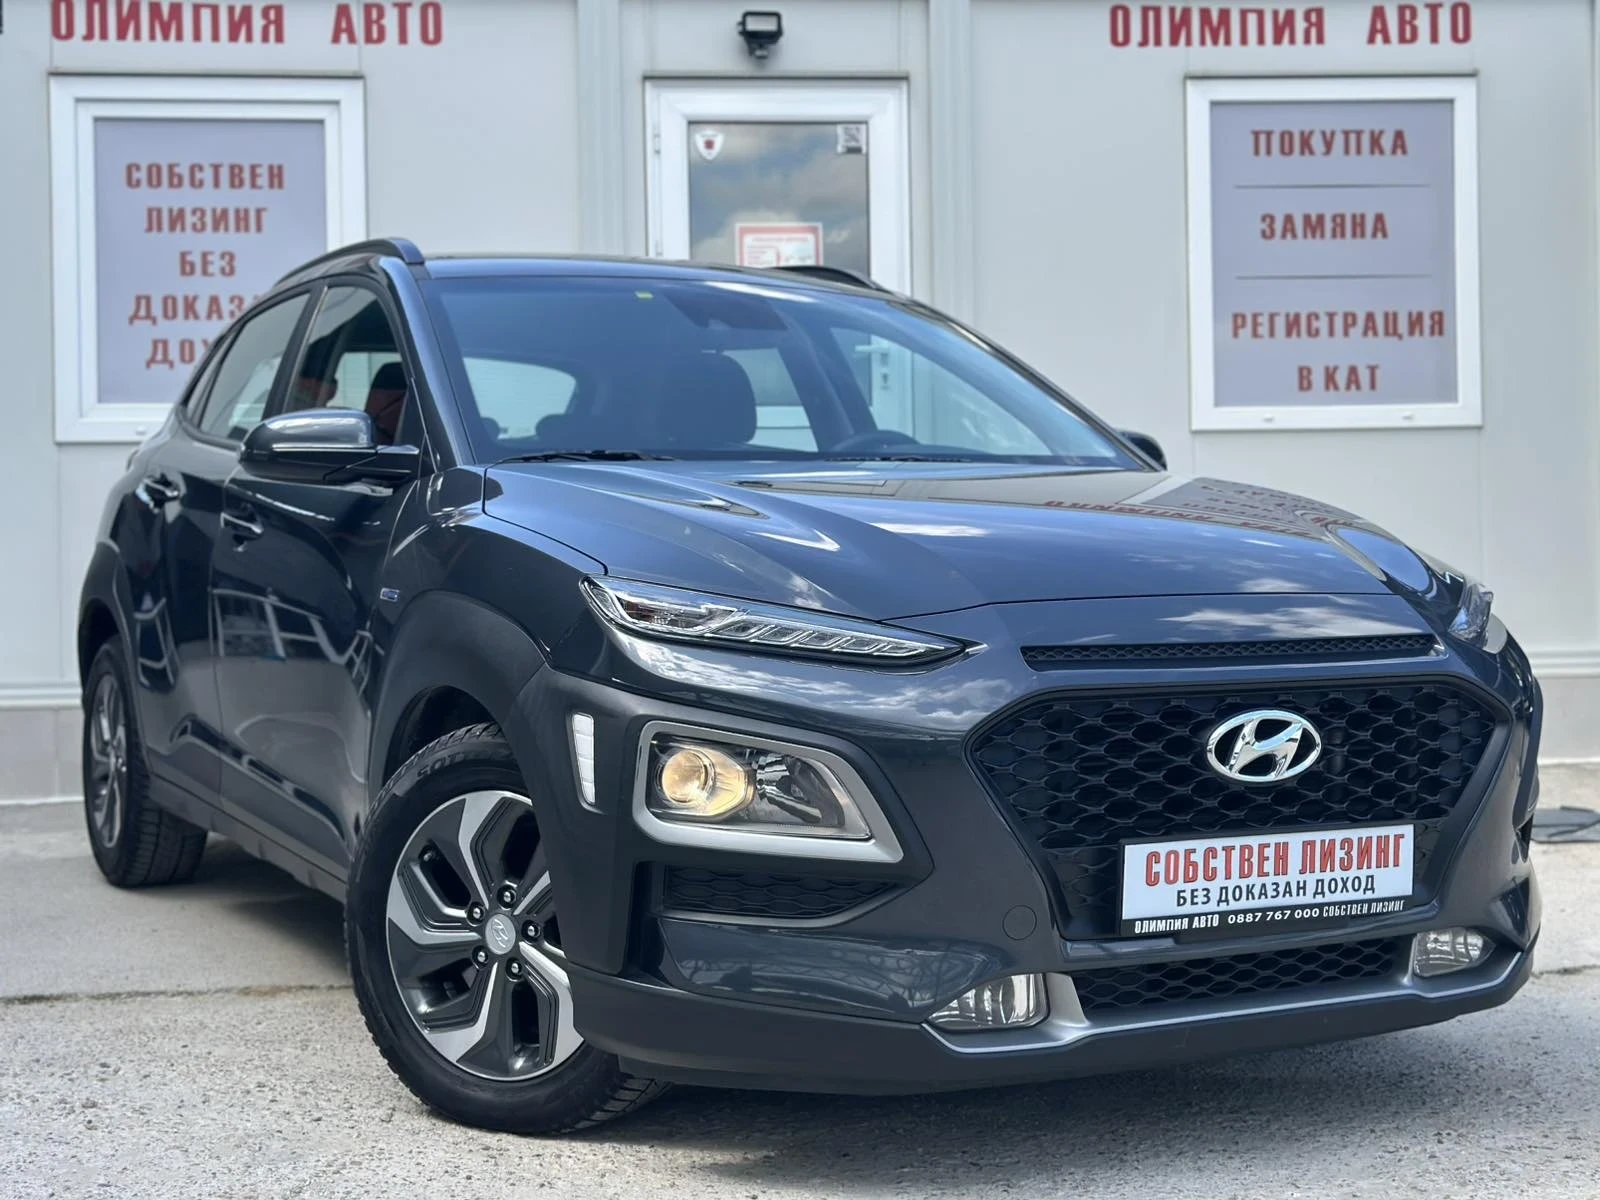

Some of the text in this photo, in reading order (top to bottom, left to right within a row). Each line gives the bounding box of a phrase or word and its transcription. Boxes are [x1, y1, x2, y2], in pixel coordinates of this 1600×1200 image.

[51, 0, 443, 46] ОЛИМПИЯ АВТО
[1109, 2, 1472, 47] ОЛИМПИЯ АВТО
[1252, 129, 1408, 156] ПОКУПКА
[125, 163, 285, 189] СОБСТВЕН
[145, 208, 267, 233] ЛИЗИНГ
[1260, 213, 1389, 240] ЗАМЯНА
[180, 252, 236, 277] БЕЗ
[128, 294, 256, 325] ДОКАЗ
[1232, 311, 1445, 340] РЕГИСТРАЦИЯ
[1298, 365, 1380, 391] В КАТ
[1145, 834, 1405, 886] СОБСТВЕН ЛИЗИНГ
[1176, 874, 1376, 907] БЕЗ ДОКАЗАН ДОХОД
[1134, 900, 1405, 934] ОЛИМПИЯ АВТО 0887 767 000 СОБСТВЕН ЛИЗИНГ
